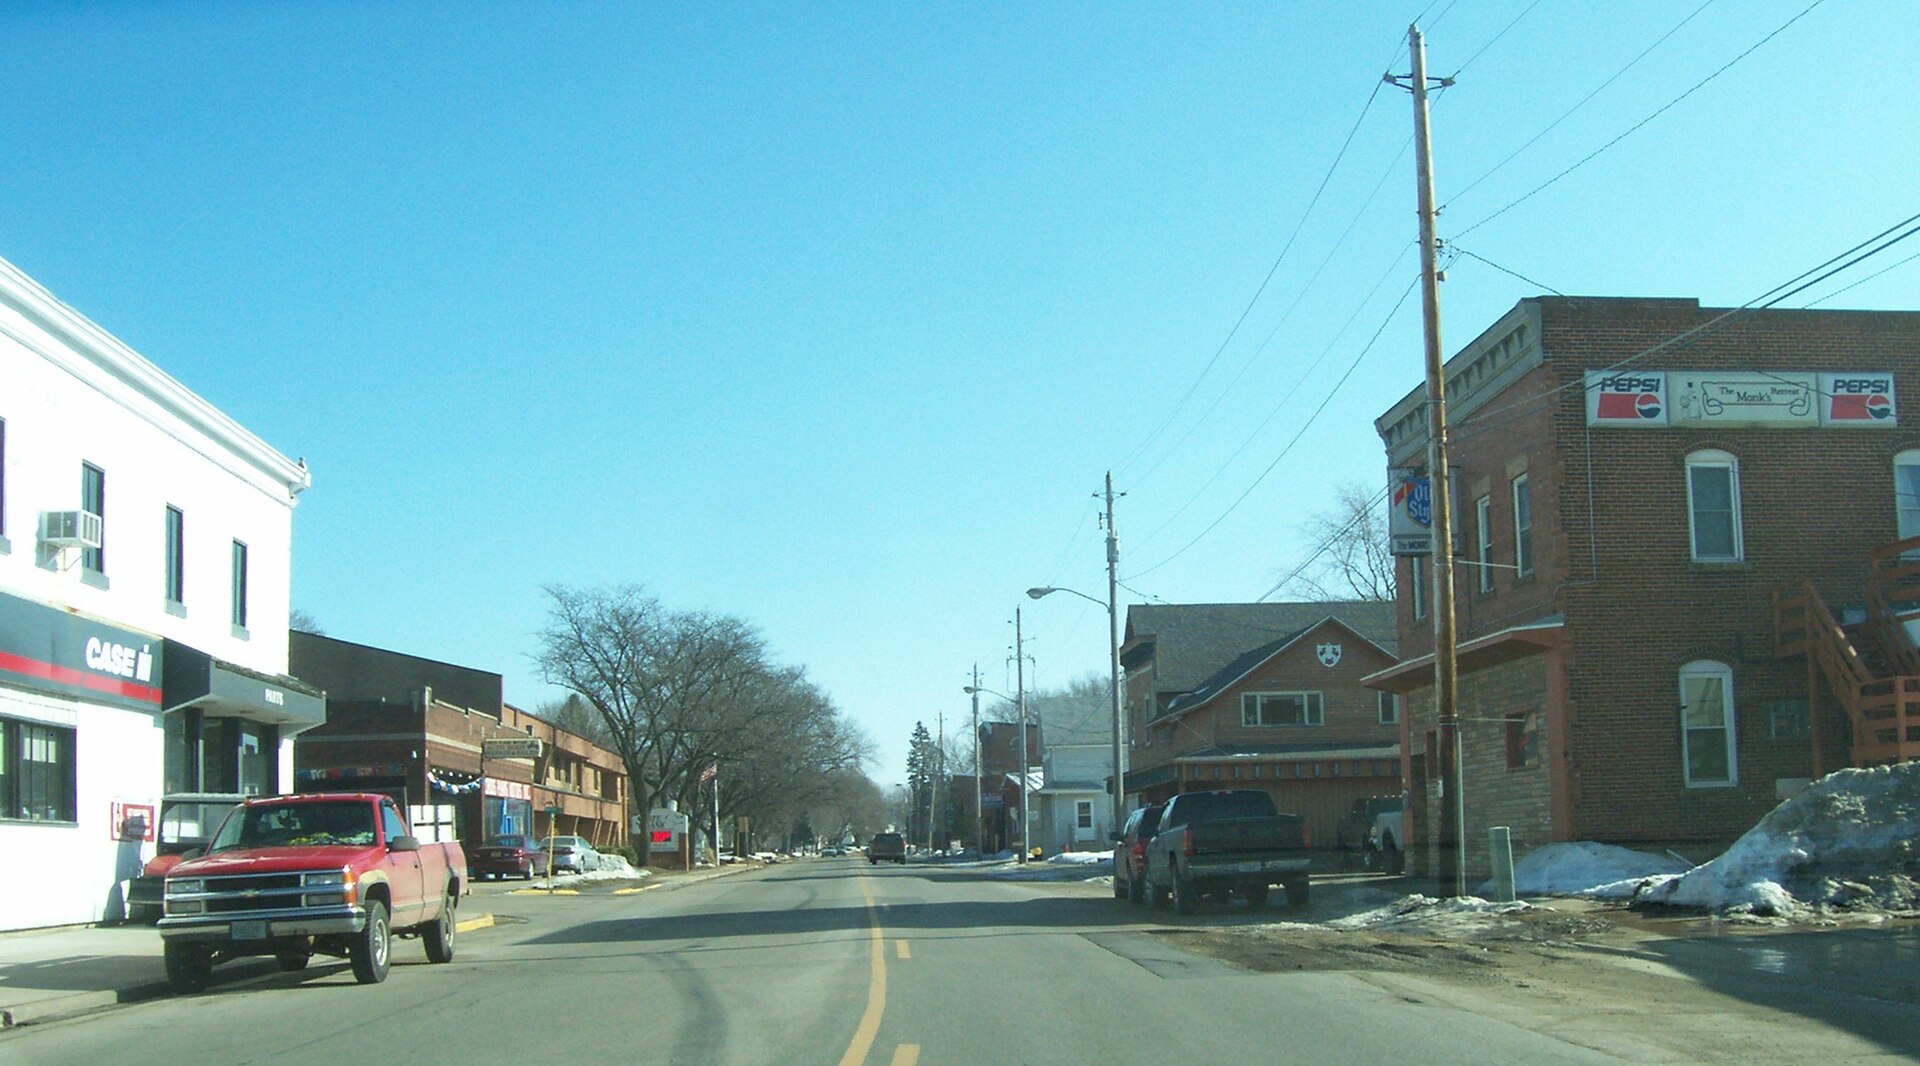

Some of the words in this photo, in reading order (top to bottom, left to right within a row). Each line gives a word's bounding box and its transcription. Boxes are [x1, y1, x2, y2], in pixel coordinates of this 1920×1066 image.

[1600, 377, 1661, 393] PEPSI
[1719, 386, 1735, 395] The
[1737, 391, 1773, 402] Monk's
[1833, 379, 1889, 394] PEPSI
[1414, 484, 1430, 502] Ol
[1408, 500, 1430, 524] Sty
[86, 636, 136, 678] CASE
[265, 688, 284, 706] PARTS
